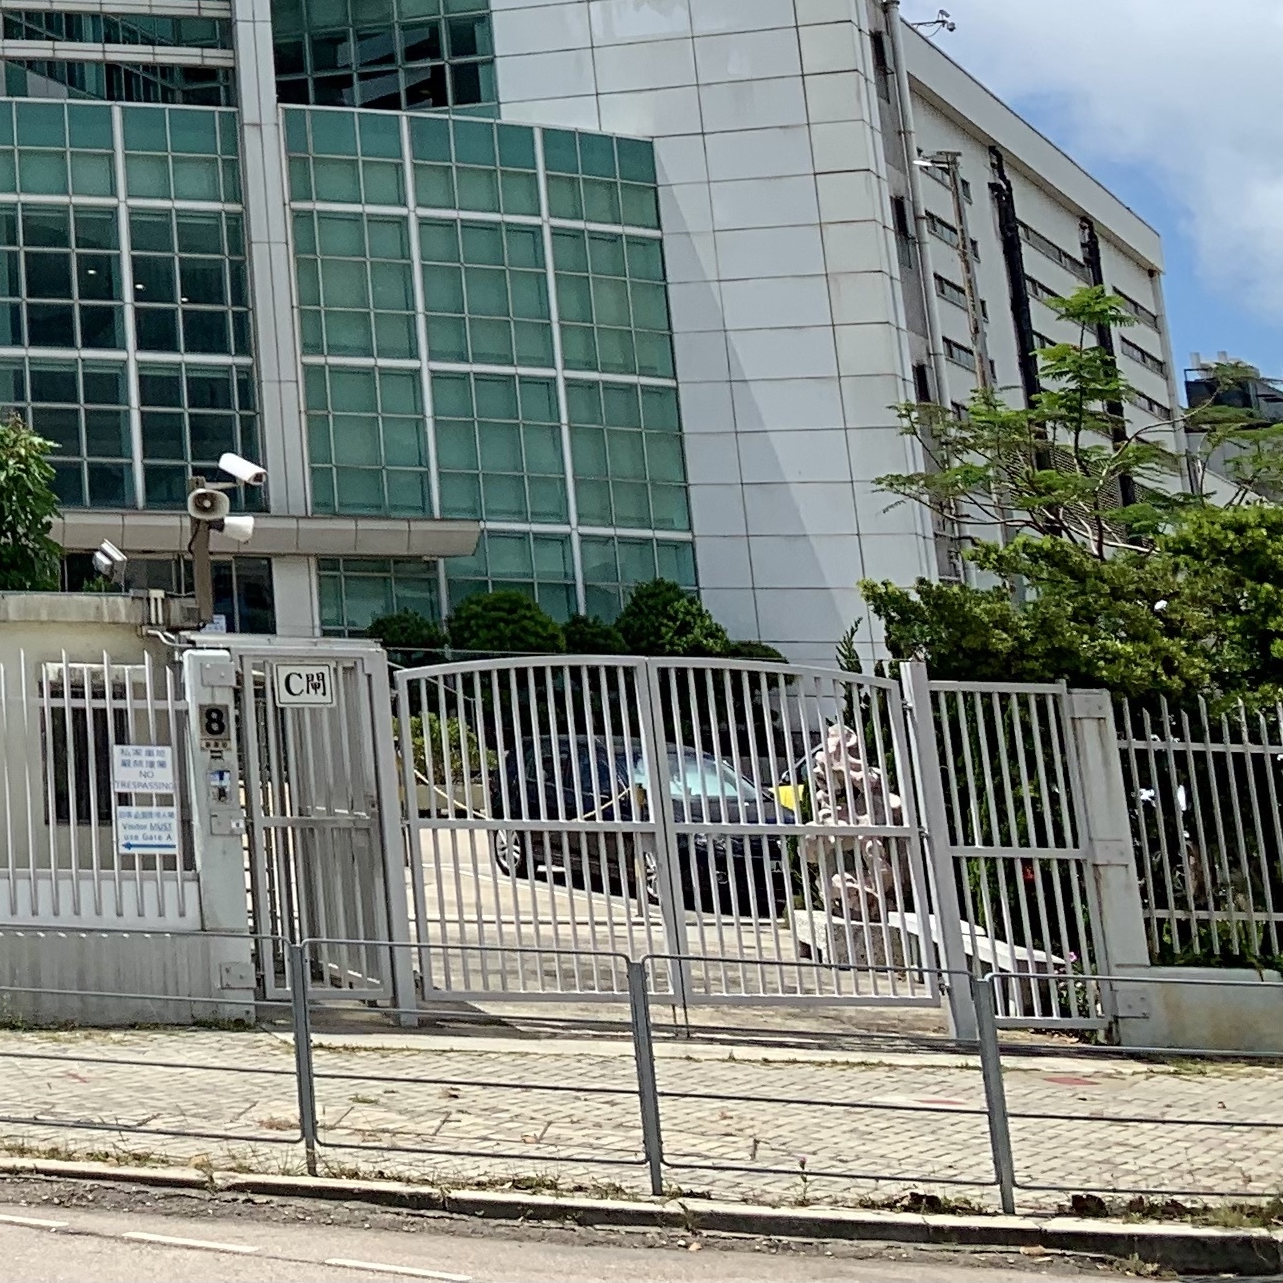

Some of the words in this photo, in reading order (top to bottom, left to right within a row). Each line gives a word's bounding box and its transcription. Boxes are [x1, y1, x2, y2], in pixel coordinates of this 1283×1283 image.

[205, 708, 225, 735] 8
[139, 770, 155, 779] NO
[115, 780, 176, 790] TRESPASSING
[142, 832, 163, 841] Gate
